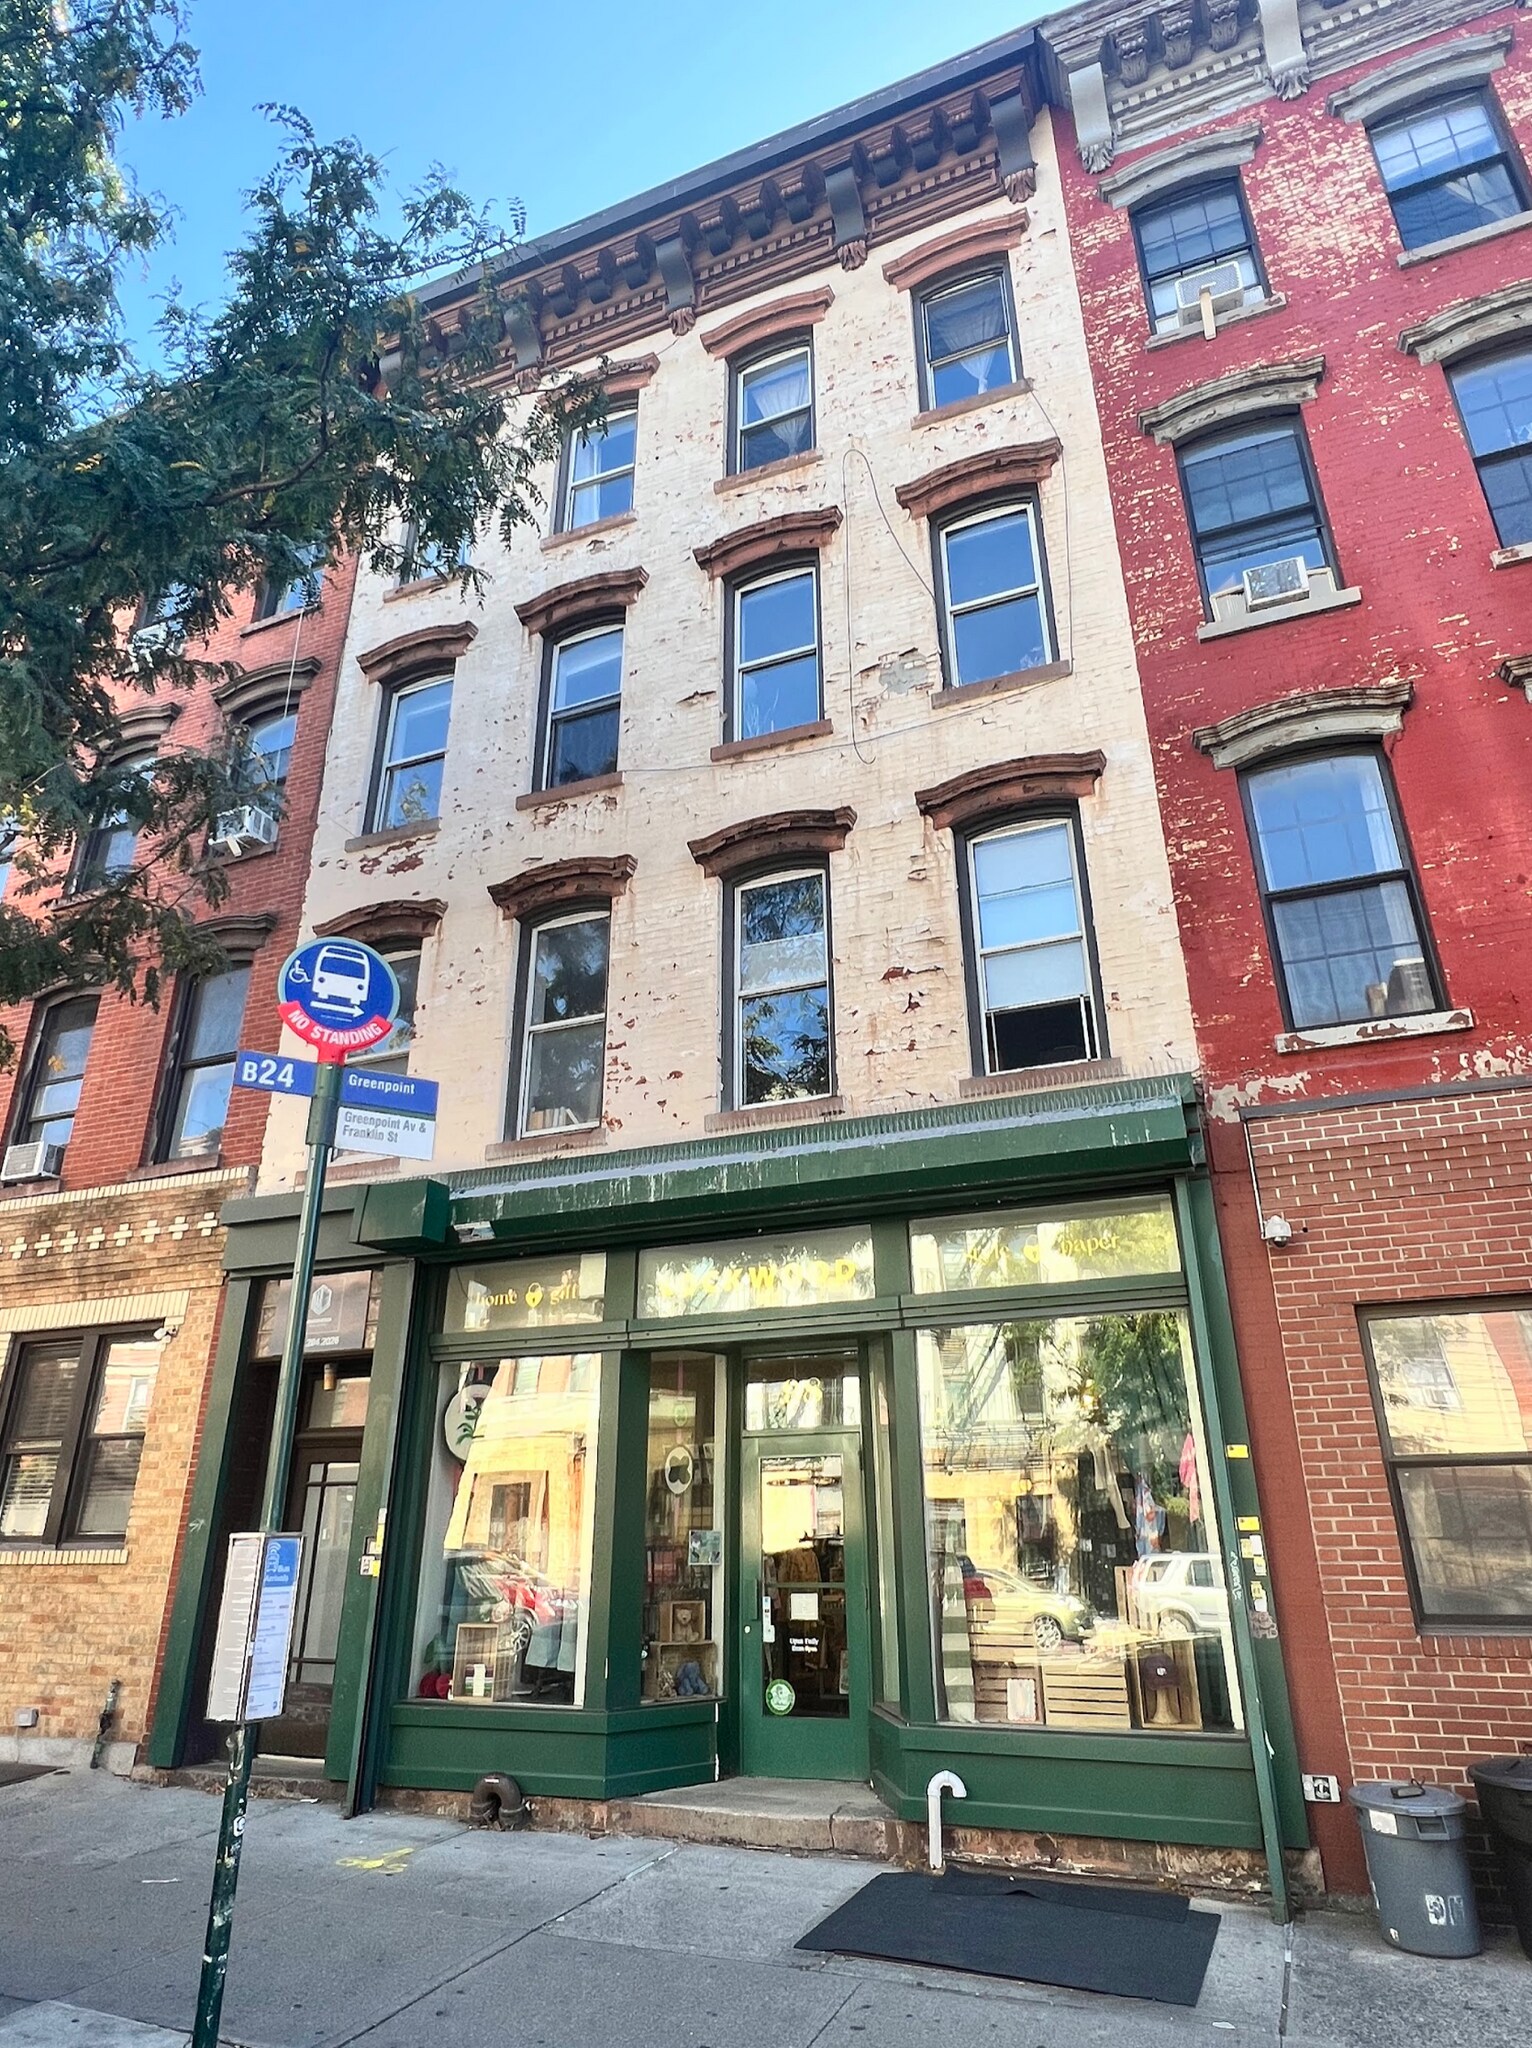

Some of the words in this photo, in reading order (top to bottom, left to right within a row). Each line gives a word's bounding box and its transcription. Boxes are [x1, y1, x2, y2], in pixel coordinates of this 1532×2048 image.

[287, 1009, 311, 1030] NO
[310, 1022, 383, 1046] STANDING
[242, 1059, 295, 1088] B24
[348, 1074, 416, 1095] Greenpoint
[342, 1125, 385, 1142] Franklin
[387, 1131, 399, 1143] St
[344, 1111, 401, 1129] Greenpoint
[402, 1120, 416, 1131] Av
[418, 1122, 427, 1133] &
[657, 1258, 857, 1299] LOCKWOOD
